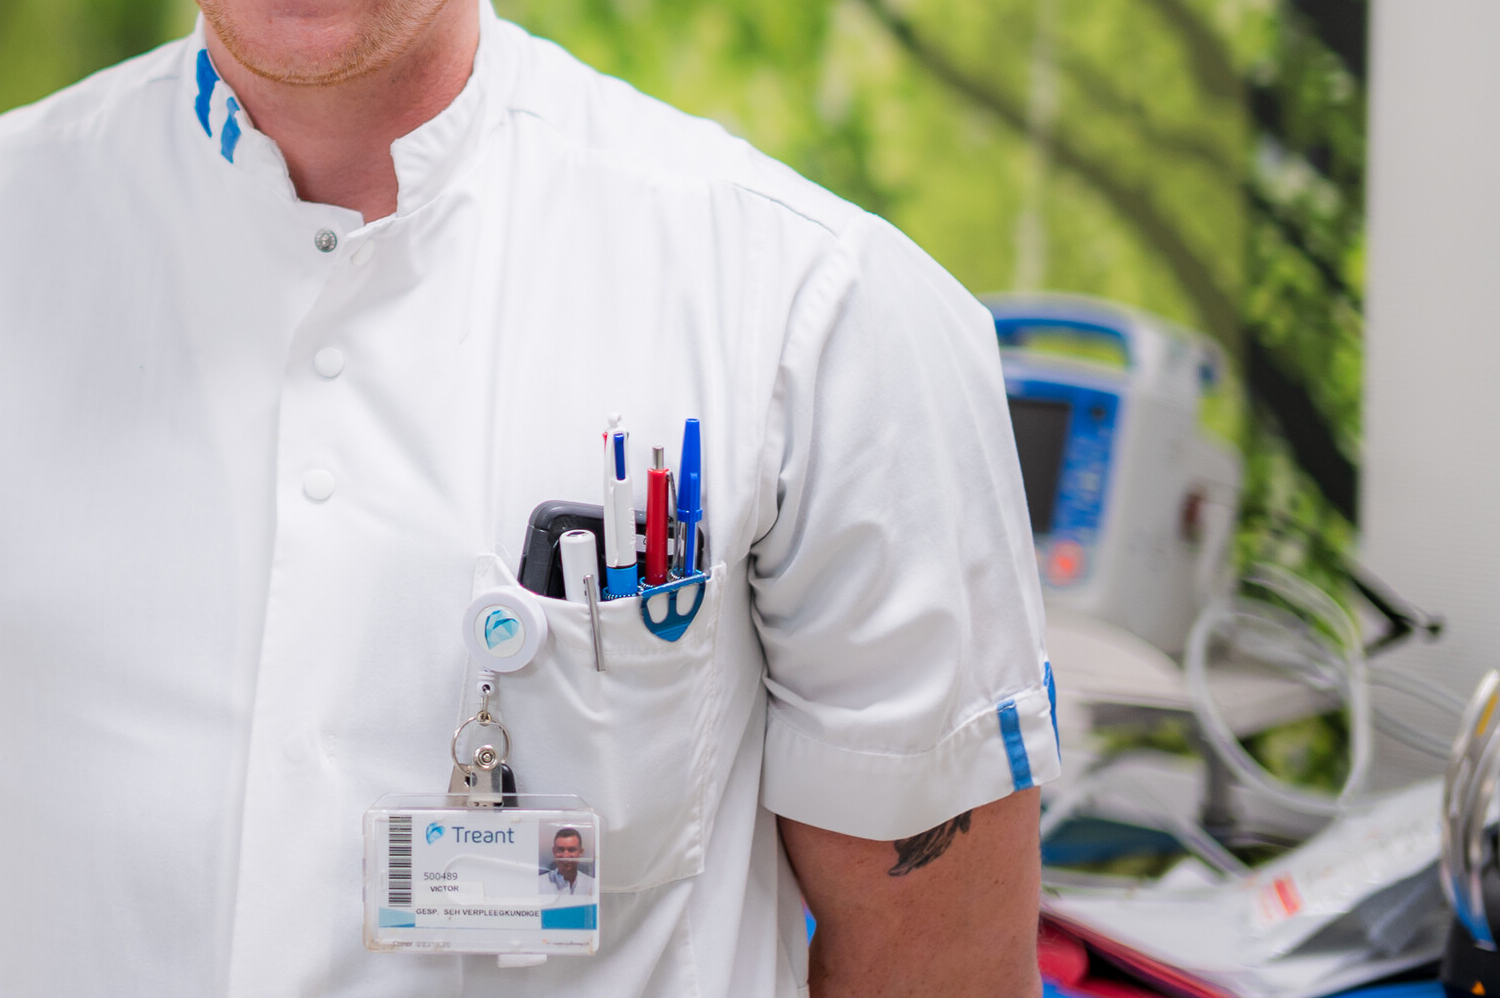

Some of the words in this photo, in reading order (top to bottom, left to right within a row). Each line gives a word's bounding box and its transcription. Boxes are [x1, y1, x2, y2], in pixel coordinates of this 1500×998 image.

[452, 826, 514, 844] Treant
[423, 872, 458, 881] 500489
[462, 909, 540, 917] VERPLEEGKUNDIGE
